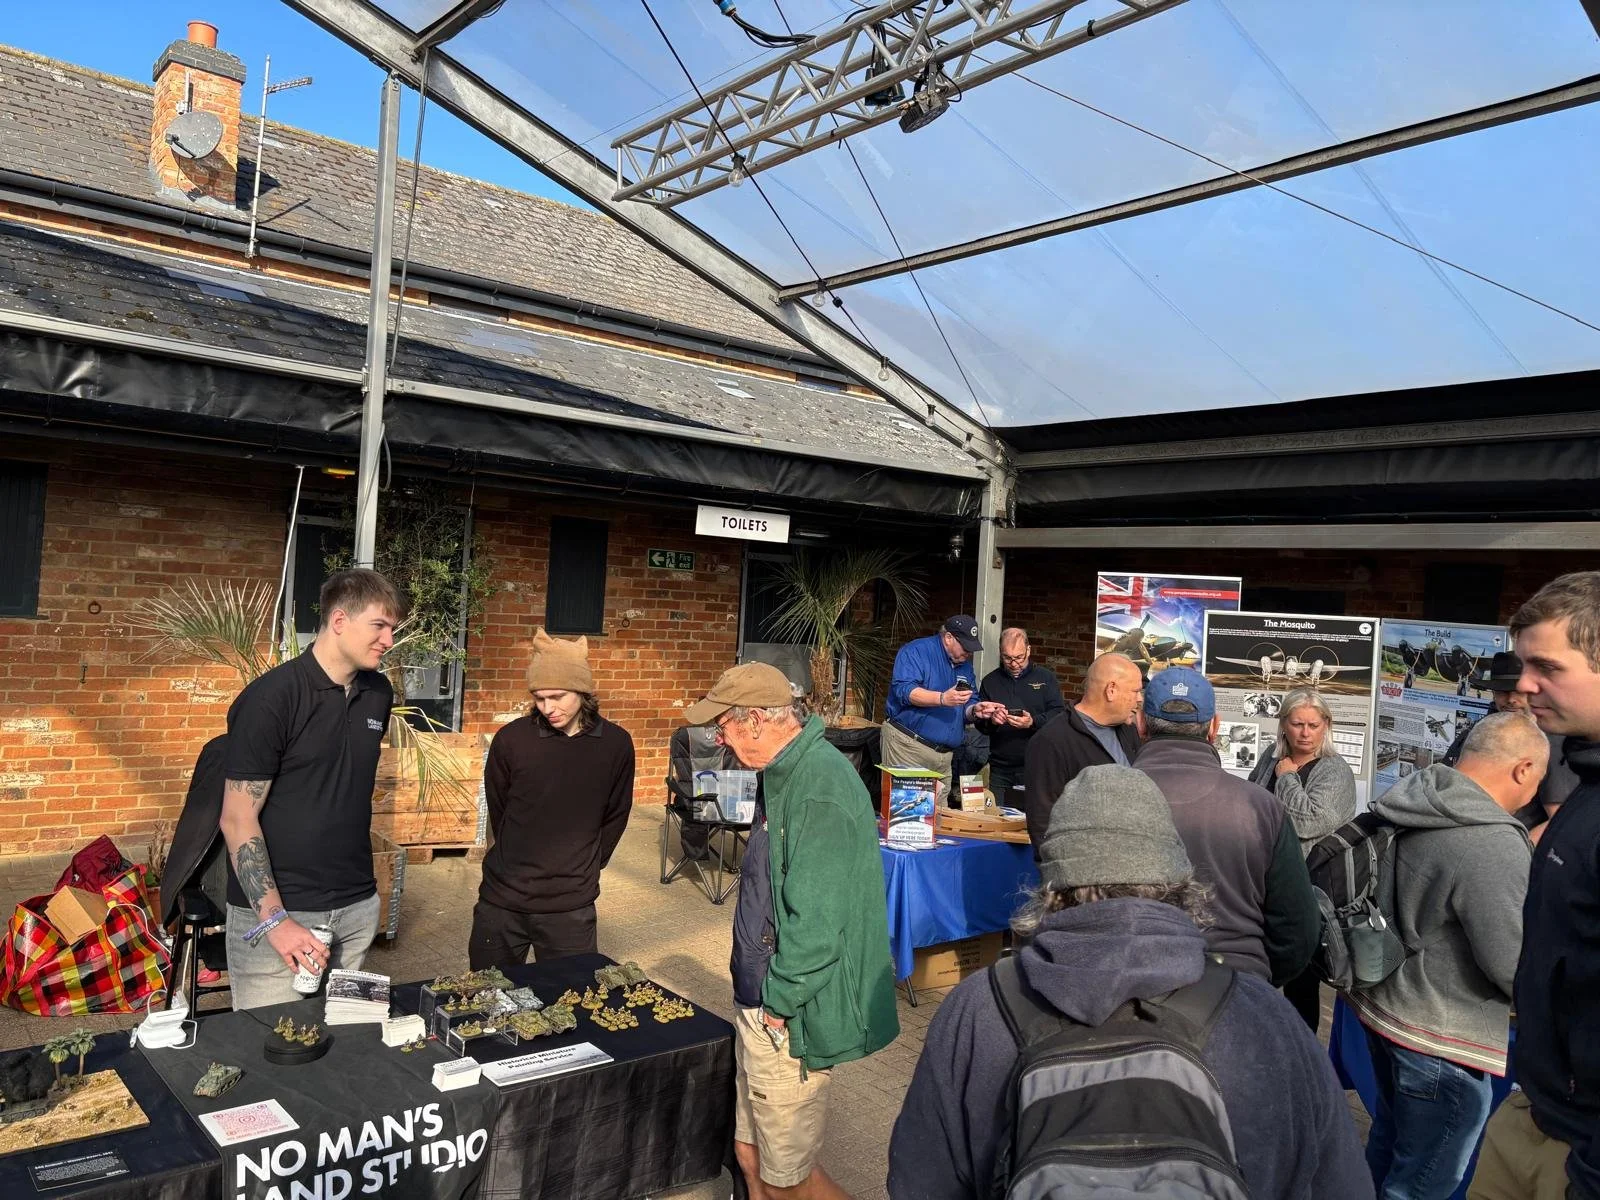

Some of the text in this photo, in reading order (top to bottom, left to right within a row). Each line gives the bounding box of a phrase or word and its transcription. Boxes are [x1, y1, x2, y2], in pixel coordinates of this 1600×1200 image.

[721, 516, 768, 532] TOILETS
[679, 553, 692, 561] Fire
[1263, 619, 1316, 630] The Mosquito
[1424, 629, 1451, 639] The Build
[497, 1047, 576, 1066] Historical Miniature
[508, 1053, 574, 1069] Painting Service
[236, 1102, 444, 1188] NO MAN'S
